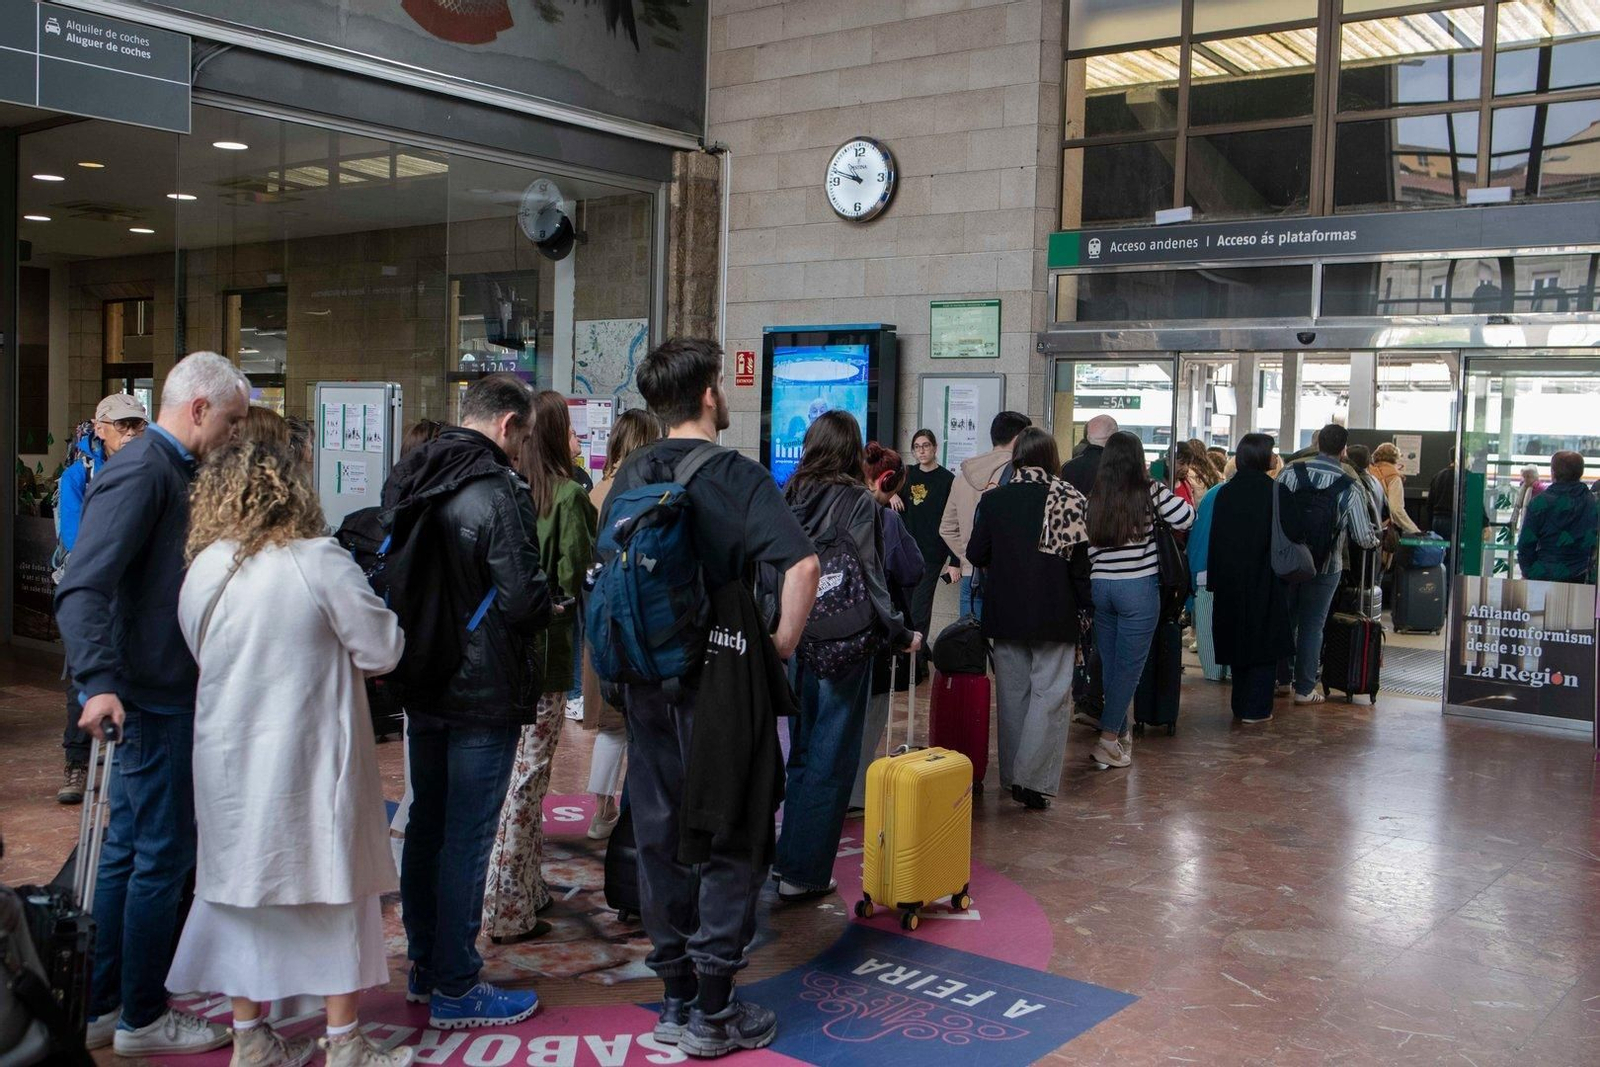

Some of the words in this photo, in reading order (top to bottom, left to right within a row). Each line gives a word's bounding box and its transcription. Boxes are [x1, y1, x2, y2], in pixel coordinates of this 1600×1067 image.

[65, 20, 103, 36] Alquiler
[105, 28, 118, 40] de
[119, 33, 149, 47] coches
[65, 32, 104, 49] Aluguer
[106, 41, 118, 52] de
[120, 45, 152, 60] coches
[854, 147, 866, 158] 12
[832, 176, 841, 187] 9
[876, 172, 885, 183] 3
[853, 202, 862, 212] 6
[1109, 239, 1147, 254] Acceso
[1149, 236, 1199, 251] andenes
[1216, 233, 1258, 247] Acceso
[1260, 230, 1275, 245] ás
[1278, 228, 1358, 247] plataformas
[1111, 396, 1125, 409] 5A
[1467, 604, 1531, 622] Afilando
[1467, 622, 1483, 635] tu
[1466, 638, 1508, 655] desde
[1511, 643, 1543, 658] 1910
[1464, 660, 1495, 679] La
[851, 957, 998, 1008] FEIRA
[1002, 998, 1047, 1019] A
